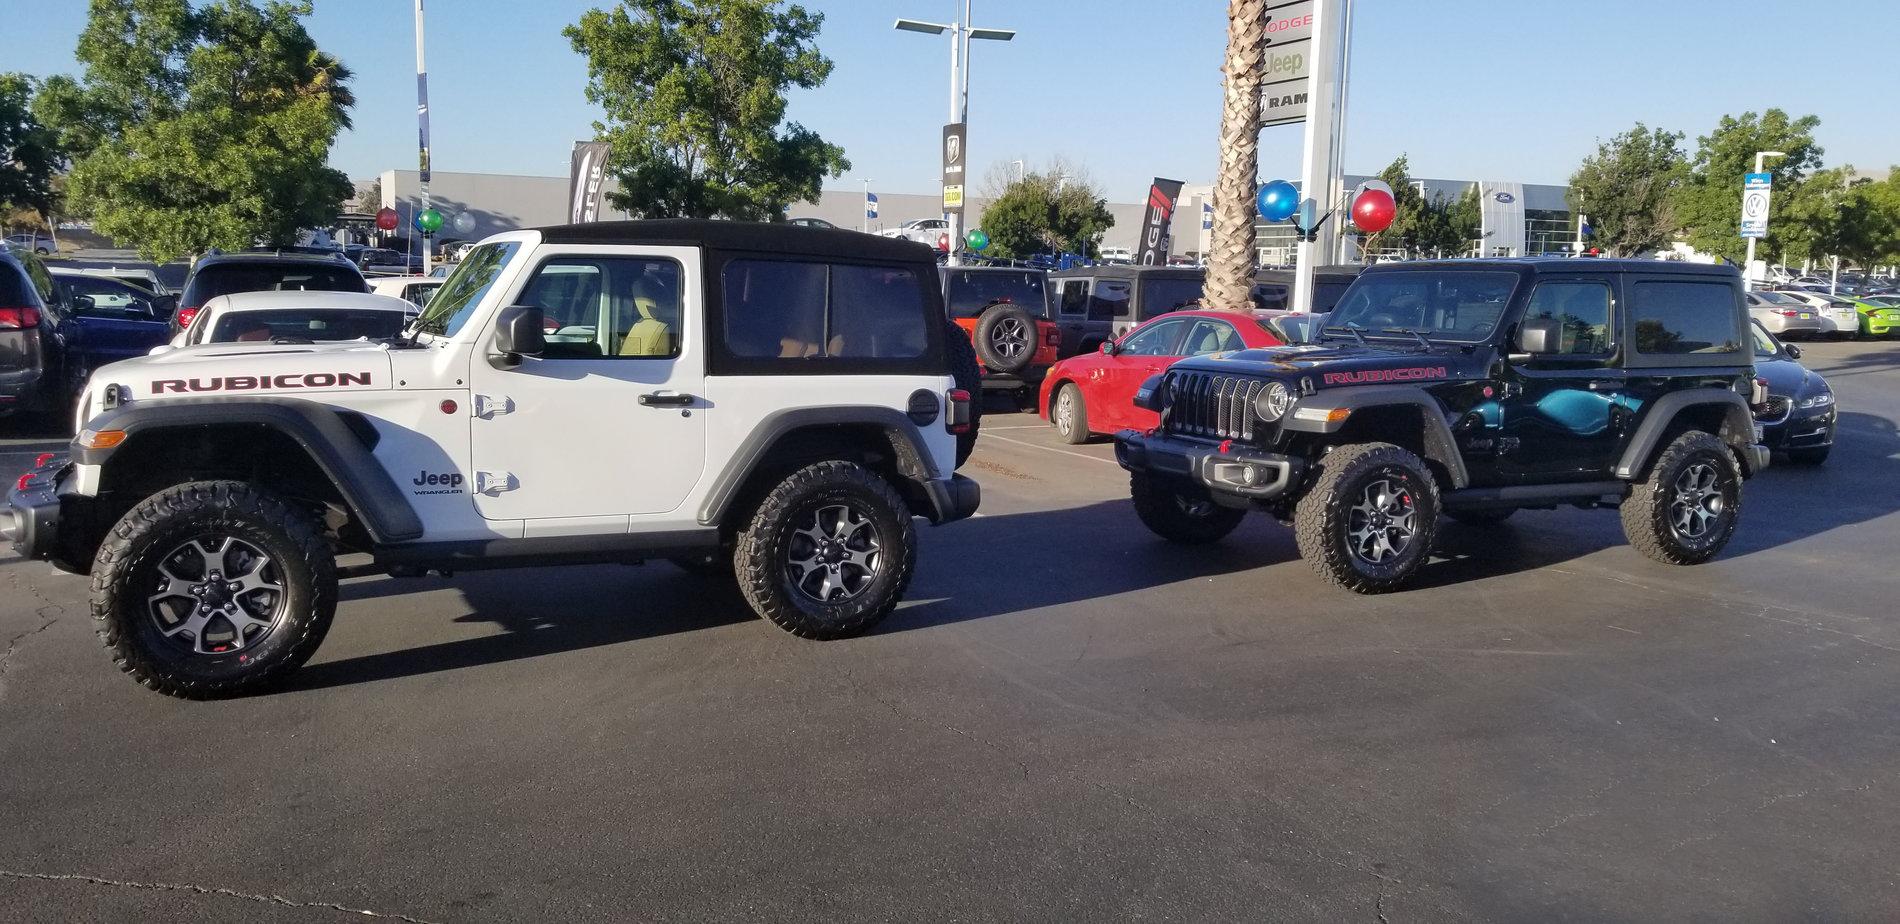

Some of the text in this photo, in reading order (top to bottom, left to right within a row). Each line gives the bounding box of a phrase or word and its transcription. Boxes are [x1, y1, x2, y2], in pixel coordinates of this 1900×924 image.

[1264, 14, 1313, 33] ODGE
[1266, 52, 1303, 75] Jeep
[1269, 92, 1308, 109] RAM
[151, 371, 372, 395] RUBICON
[1323, 366, 1447, 385] RUBICON
[413, 470, 463, 488] Jeep
